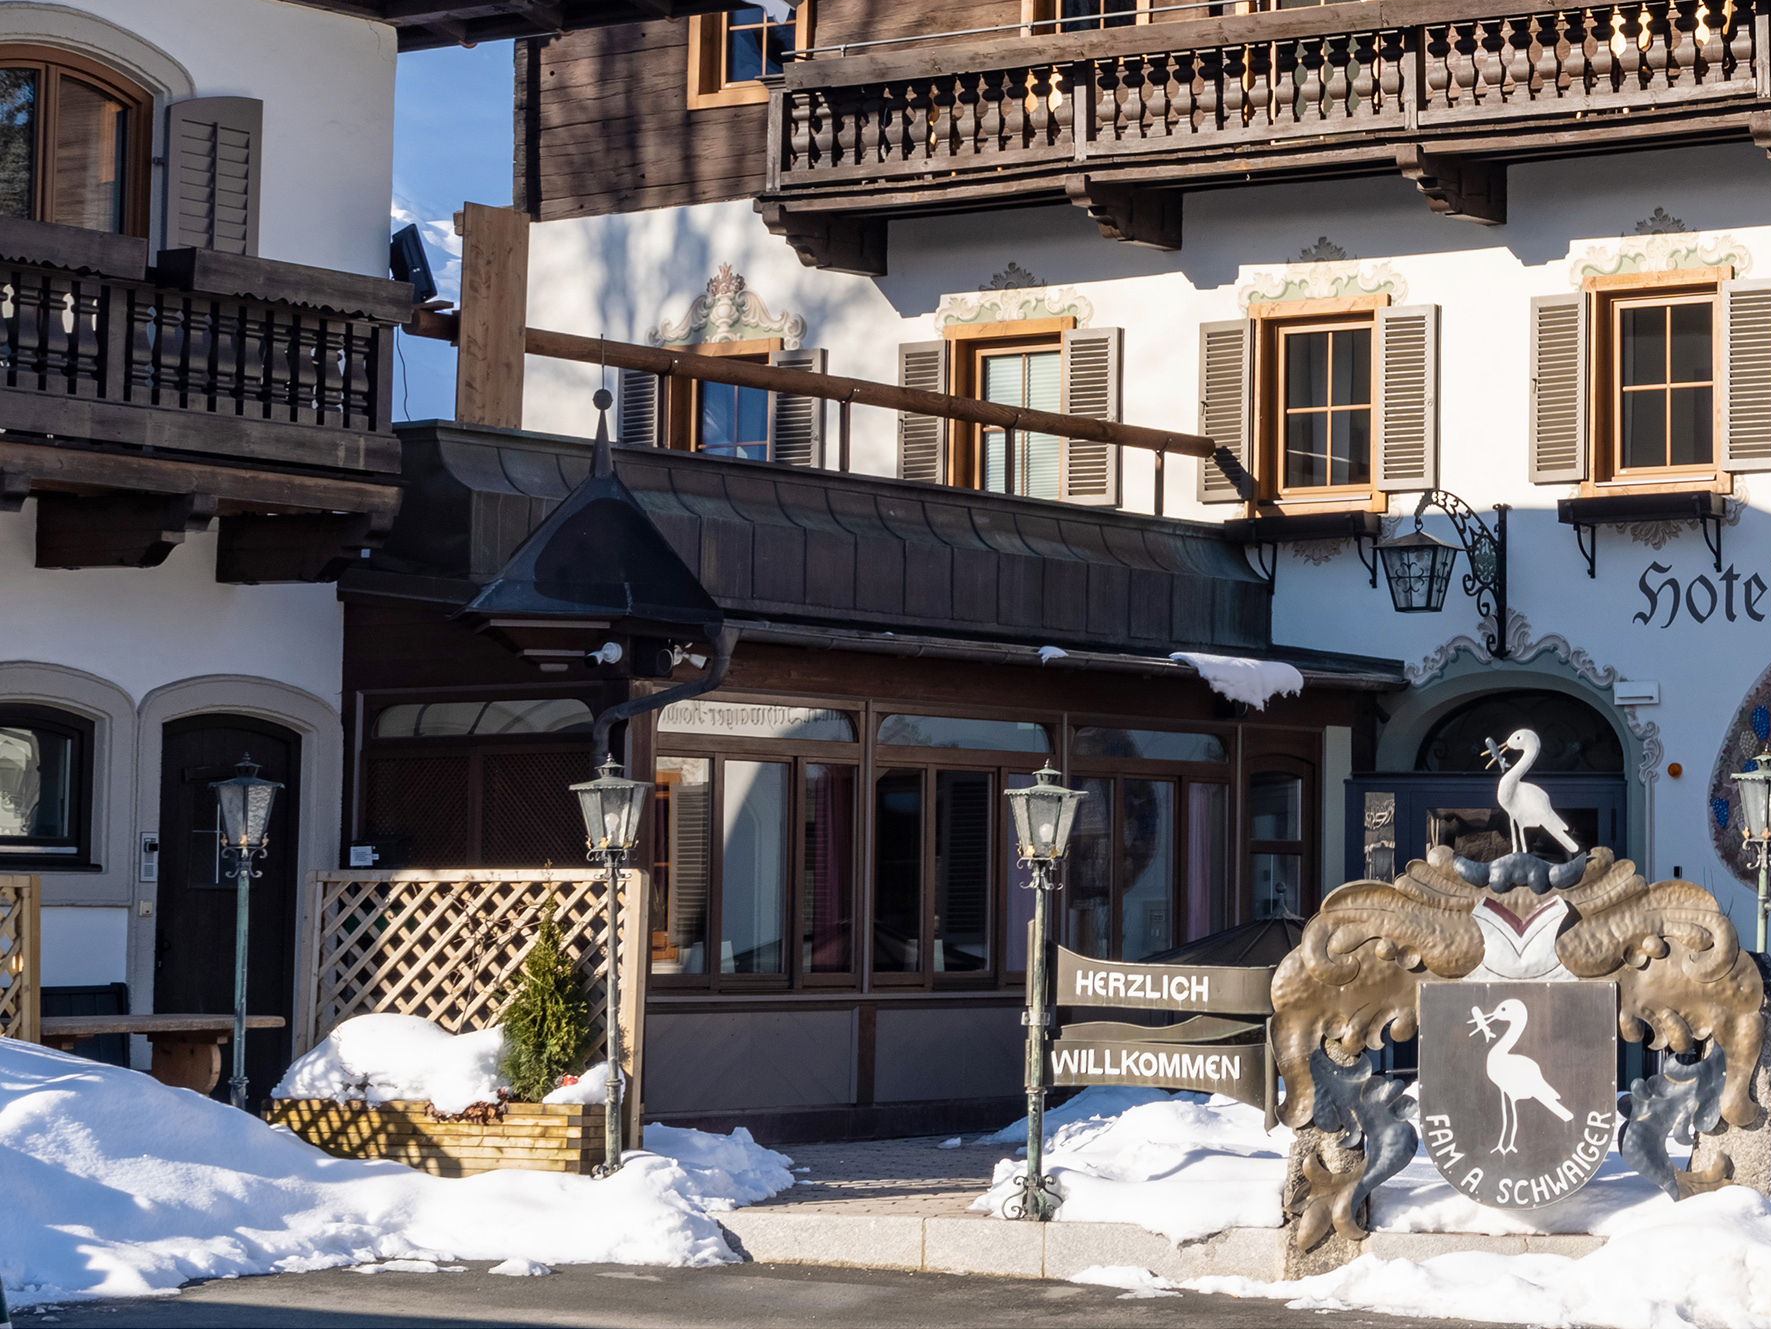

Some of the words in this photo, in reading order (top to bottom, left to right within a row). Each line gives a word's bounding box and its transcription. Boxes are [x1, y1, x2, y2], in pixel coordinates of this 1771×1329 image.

[1076, 969, 1209, 1002] HERZLICH
[1051, 1049, 1241, 1080] WILLKOMMEN
[1496, 1110, 1612, 1205] SCHWAIGER
